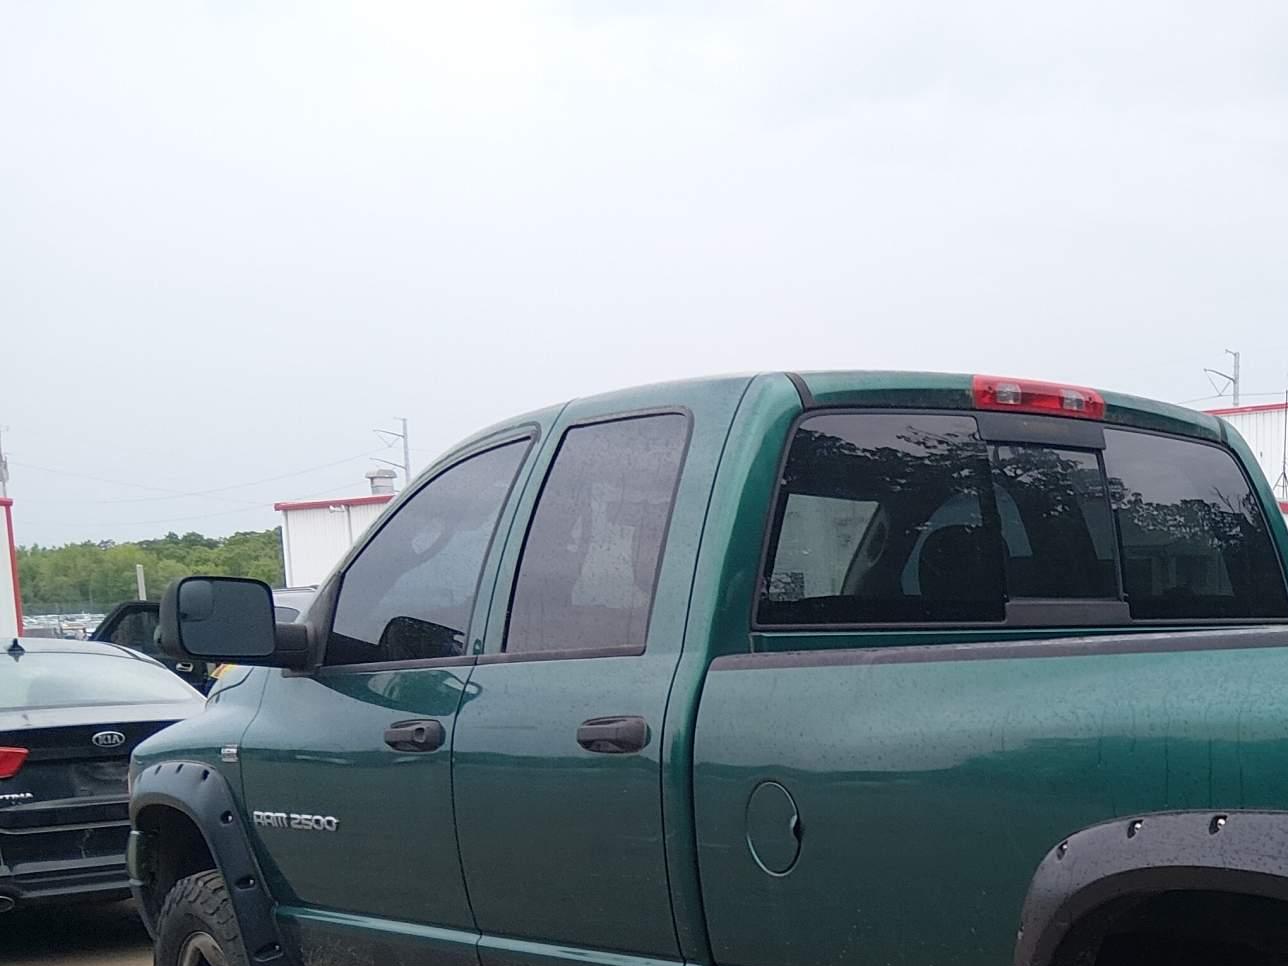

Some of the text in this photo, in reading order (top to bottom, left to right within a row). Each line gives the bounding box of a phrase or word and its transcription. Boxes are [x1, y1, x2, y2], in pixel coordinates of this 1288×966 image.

[97, 733, 122, 745] KIA
[253, 809, 337, 832] RAM 2500
